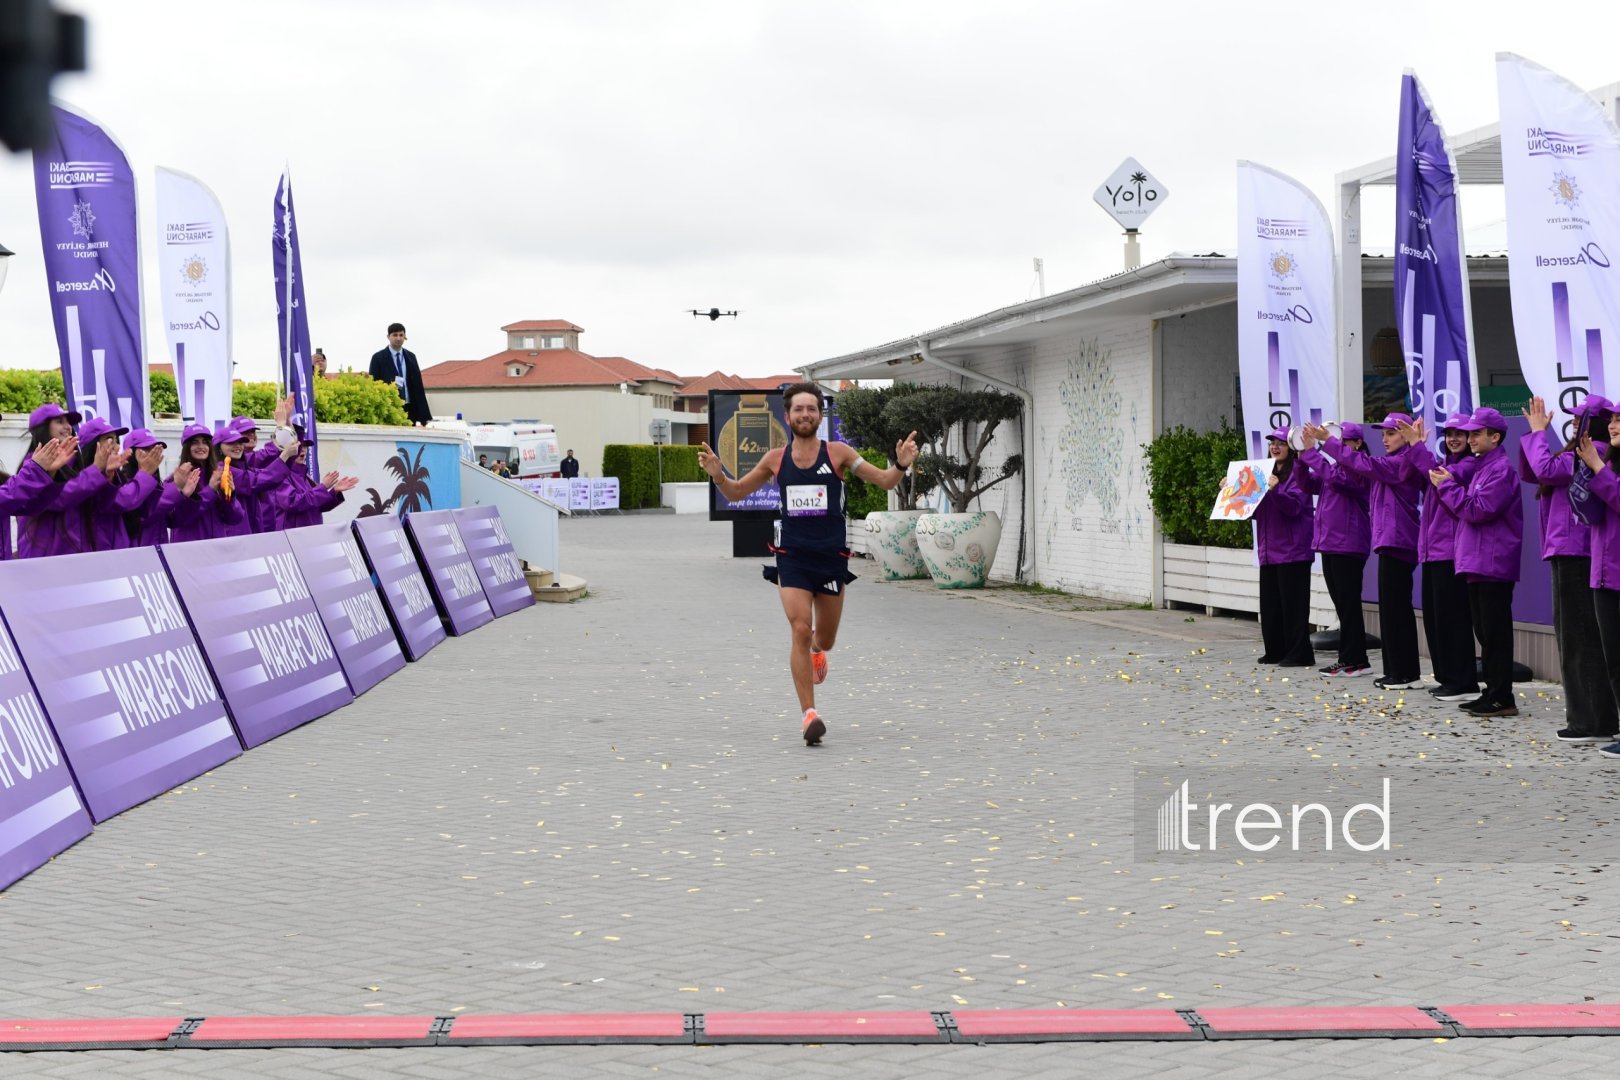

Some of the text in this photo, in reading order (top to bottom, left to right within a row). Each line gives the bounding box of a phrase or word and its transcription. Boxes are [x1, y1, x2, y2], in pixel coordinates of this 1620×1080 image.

[1105, 182, 1157, 207] Yolo
[792, 498, 822, 508] 10412
[131, 571, 187, 634] BAKI
[267, 552, 310, 603] BAKI
[251, 612, 334, 680] MARAFONU
[106, 644, 217, 731] MARAFONU
